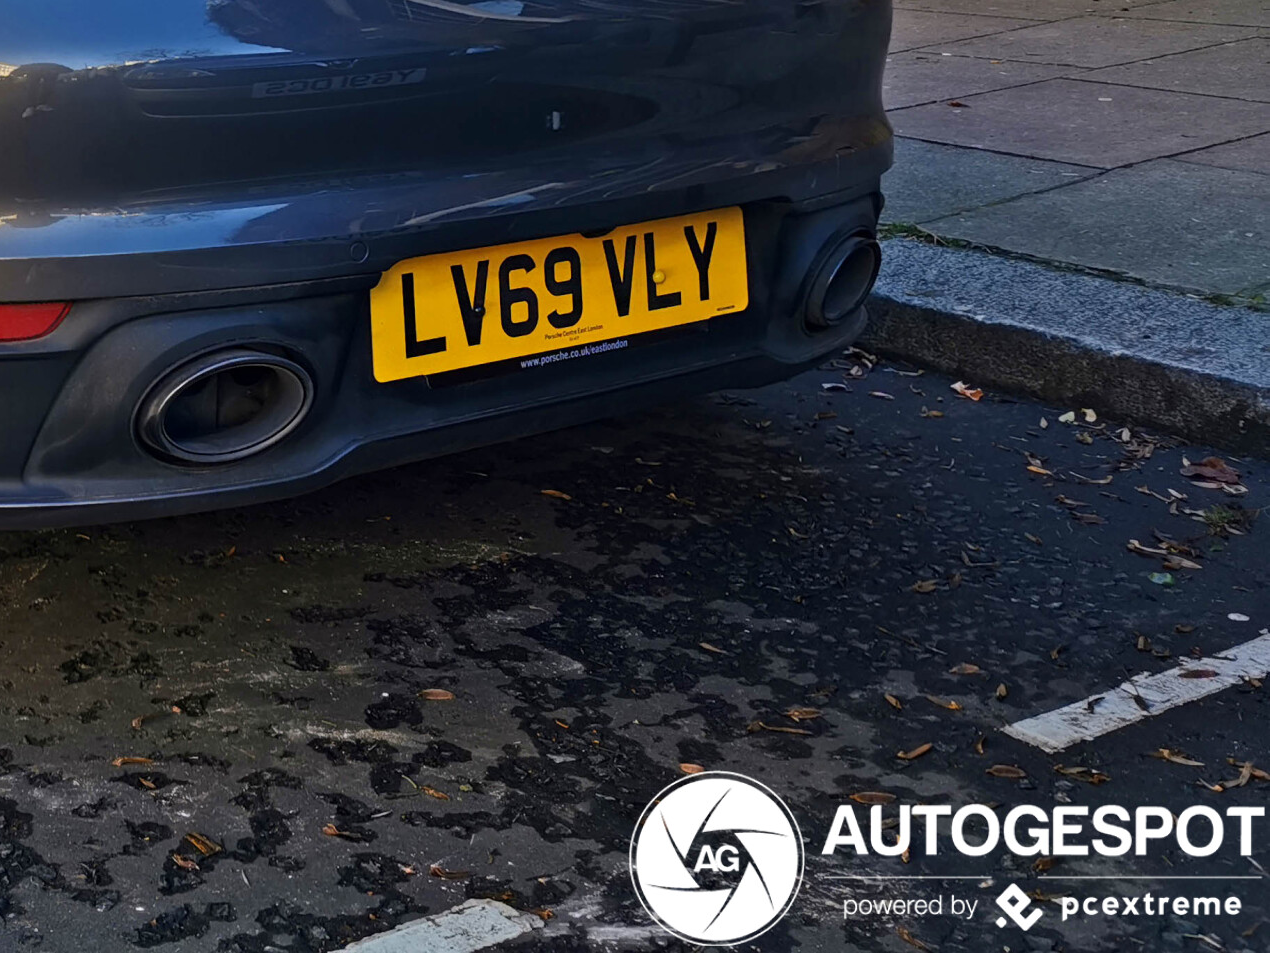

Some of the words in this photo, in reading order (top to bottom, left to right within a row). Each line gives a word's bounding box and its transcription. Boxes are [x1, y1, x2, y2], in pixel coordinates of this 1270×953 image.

[401, 246, 583, 359] LV69
[602, 221, 718, 318] VLY
[544, 332, 562, 340] Porsche
[562, 329, 577, 337] Centre
[587, 324, 603, 332] London
[520, 338, 628, 369] www.porsche.co.uk/eastlondon
